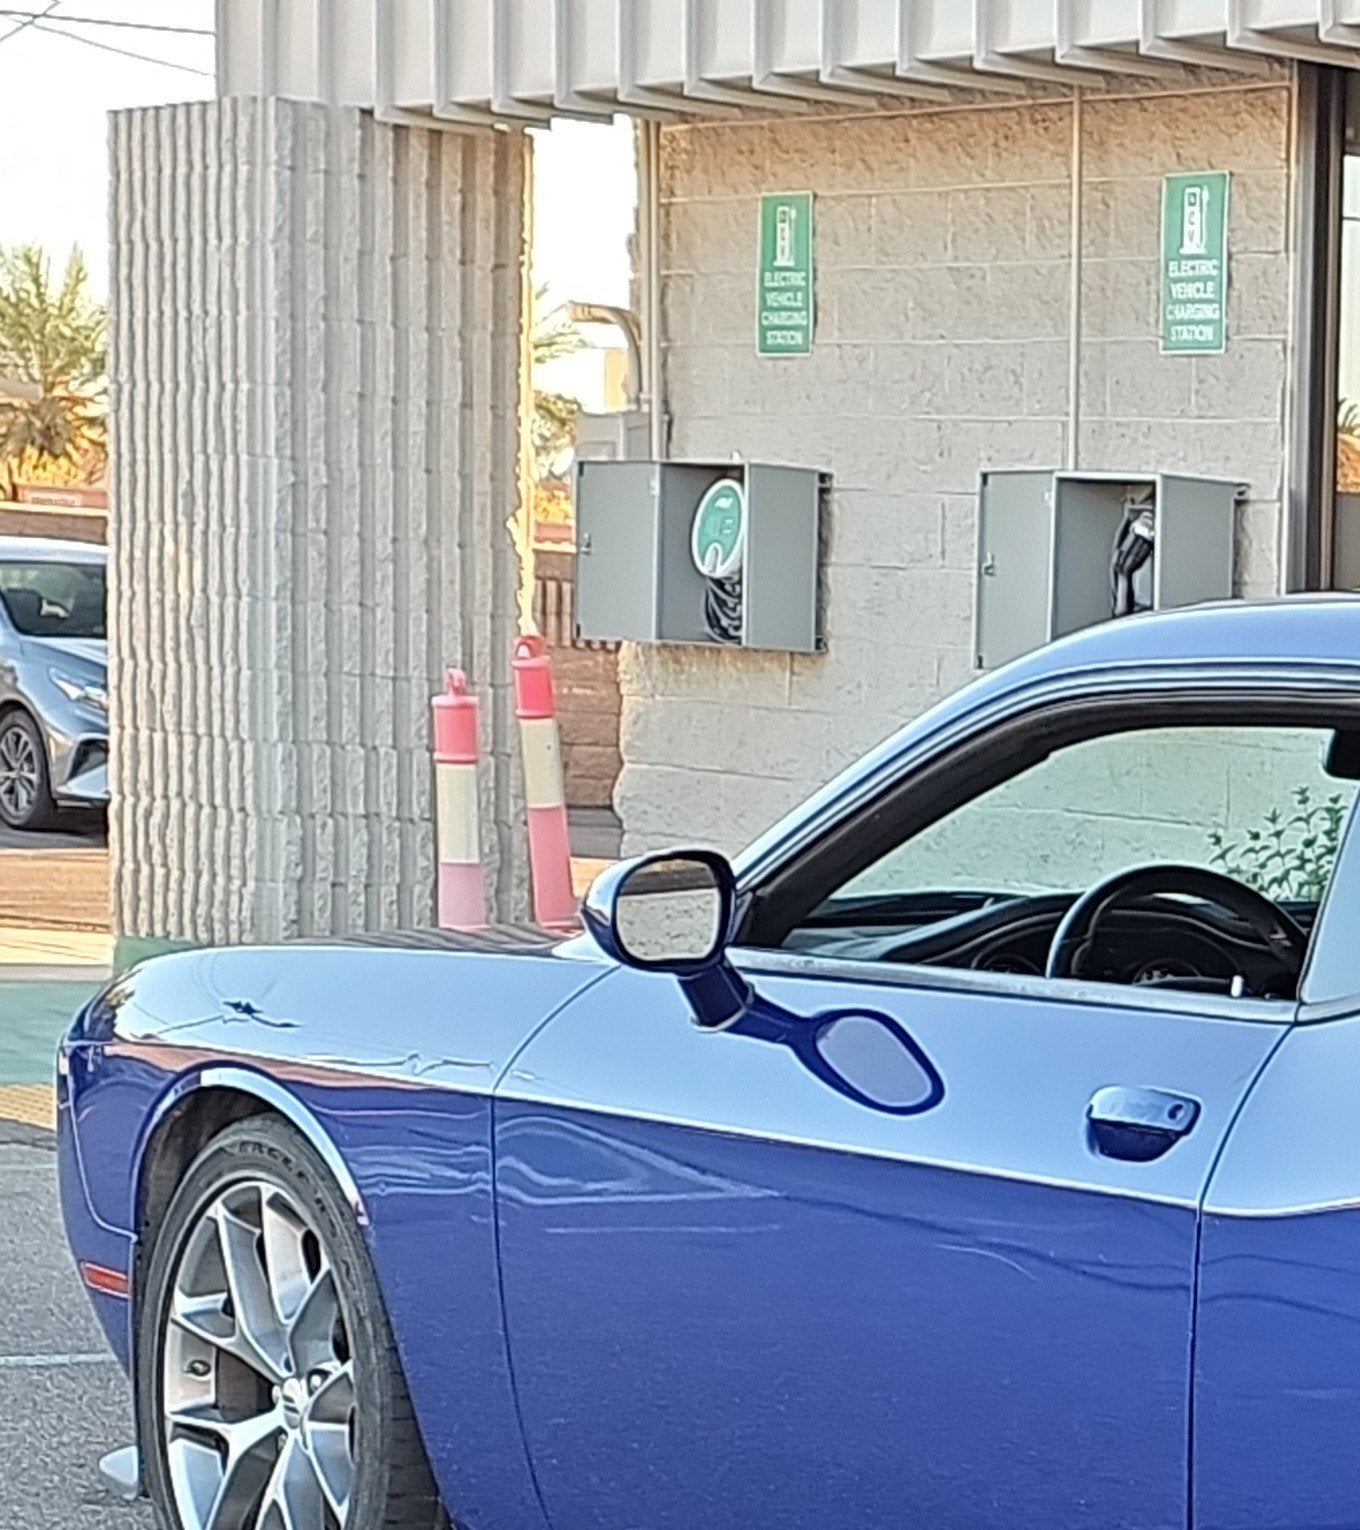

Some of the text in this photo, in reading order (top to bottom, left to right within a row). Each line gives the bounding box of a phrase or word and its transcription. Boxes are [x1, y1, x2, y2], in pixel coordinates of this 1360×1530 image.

[1167, 259, 1220, 277] ELECTRIC
[763, 271, 807, 287] ELECTRIC
[1170, 281, 1215, 299] VEHICLE
[1166, 303, 1220, 320] CHARGING
[1170, 324, 1214, 341] STATION
